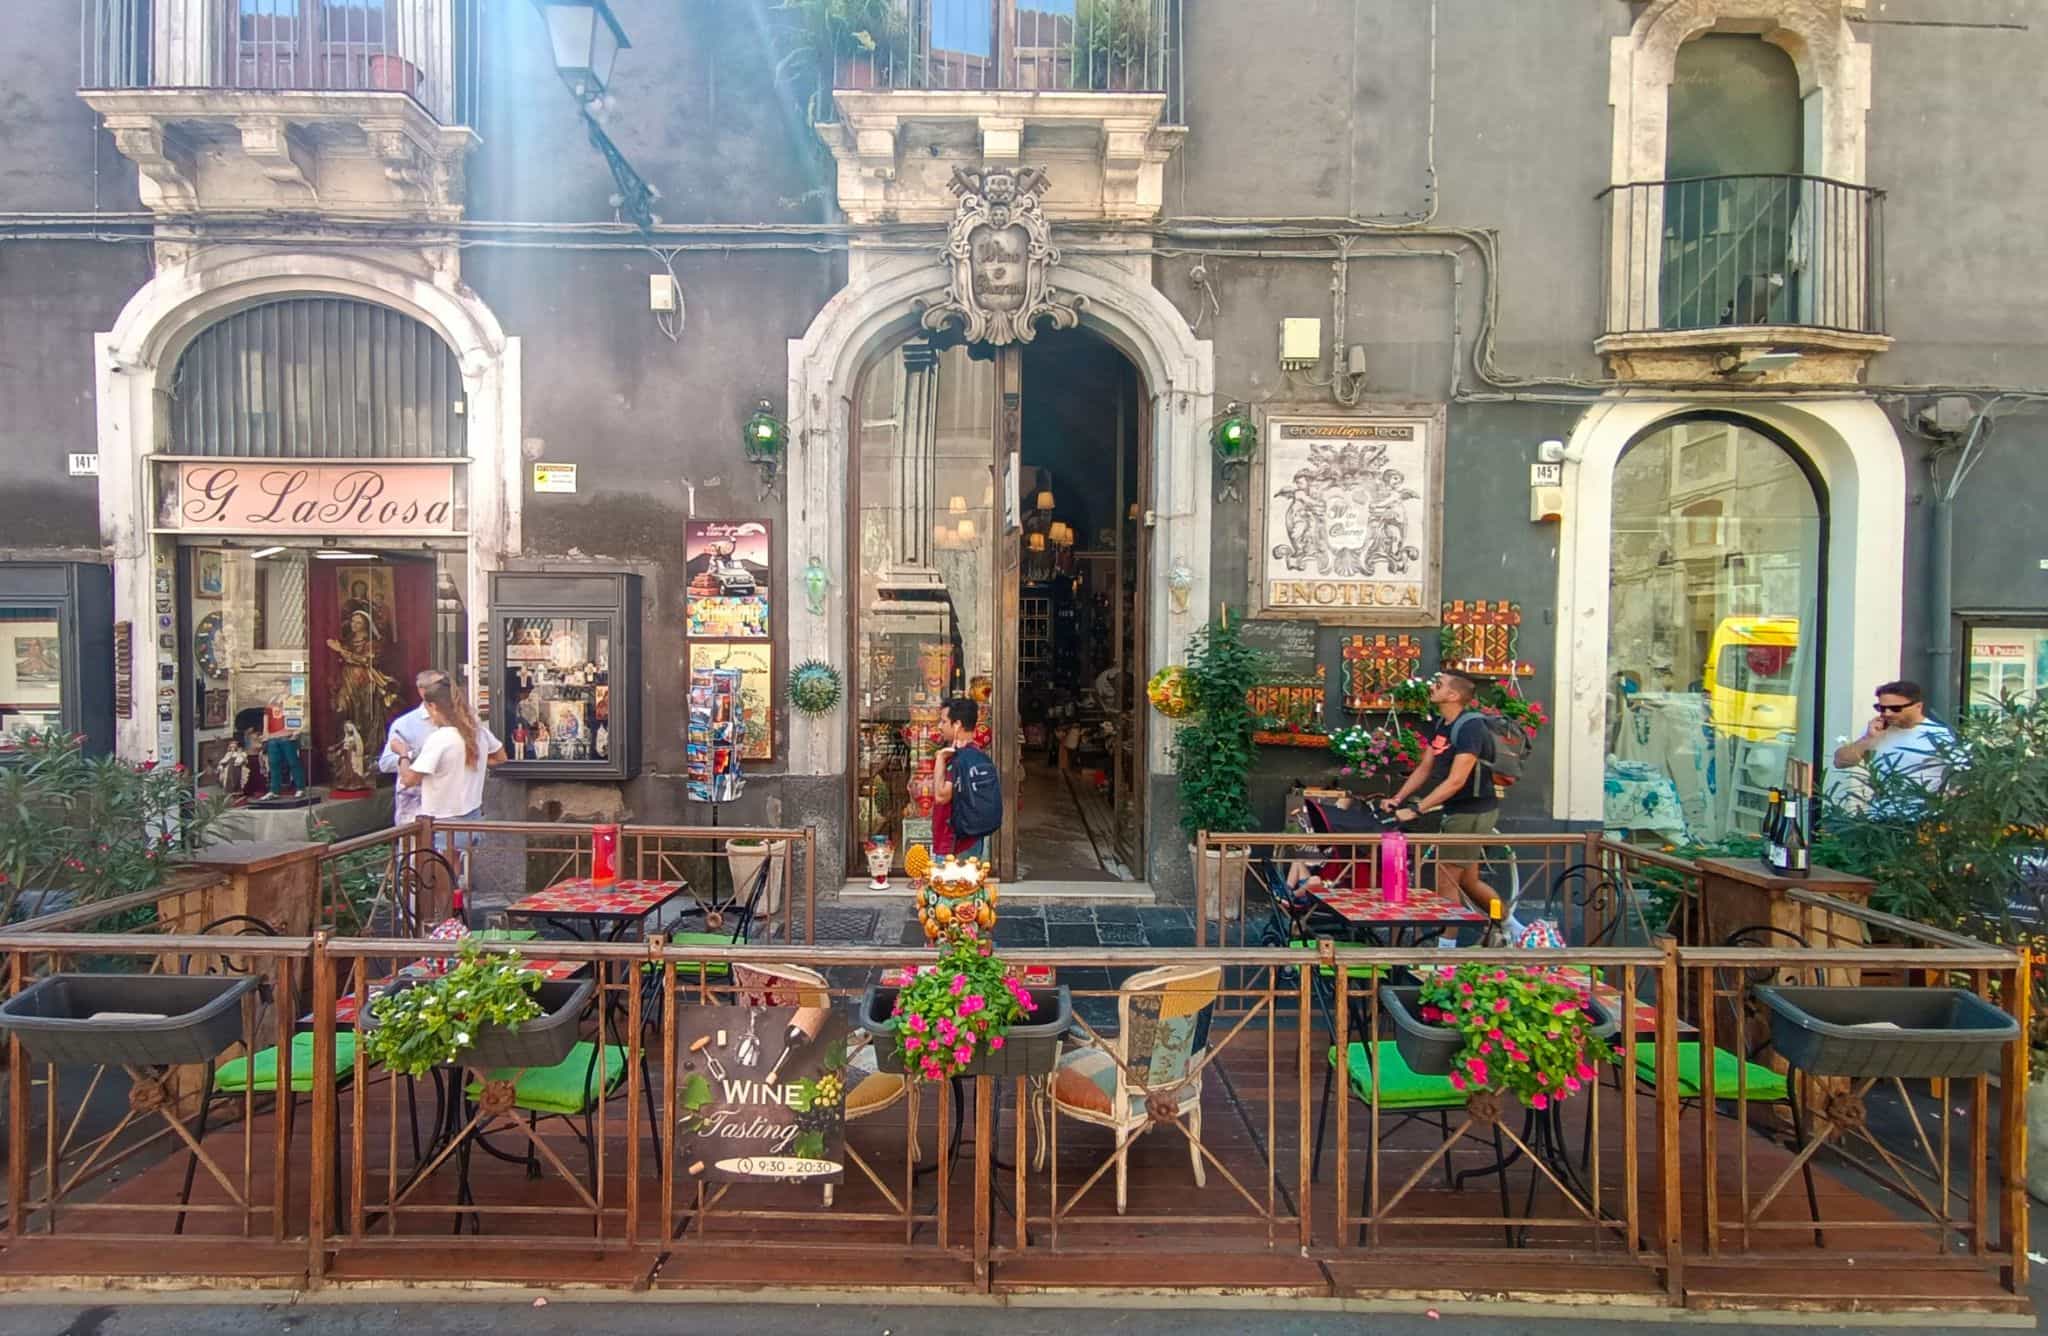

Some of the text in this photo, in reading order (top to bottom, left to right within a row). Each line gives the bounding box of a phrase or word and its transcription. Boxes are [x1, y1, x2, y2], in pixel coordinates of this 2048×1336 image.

[1273, 582, 1419, 606] ENOTECA
[723, 1079, 805, 1105] WINE
[697, 1108, 800, 1153] Tasting
[758, 1160, 785, 1173] 9:30
[797, 1161, 832, 1174] 20:30
